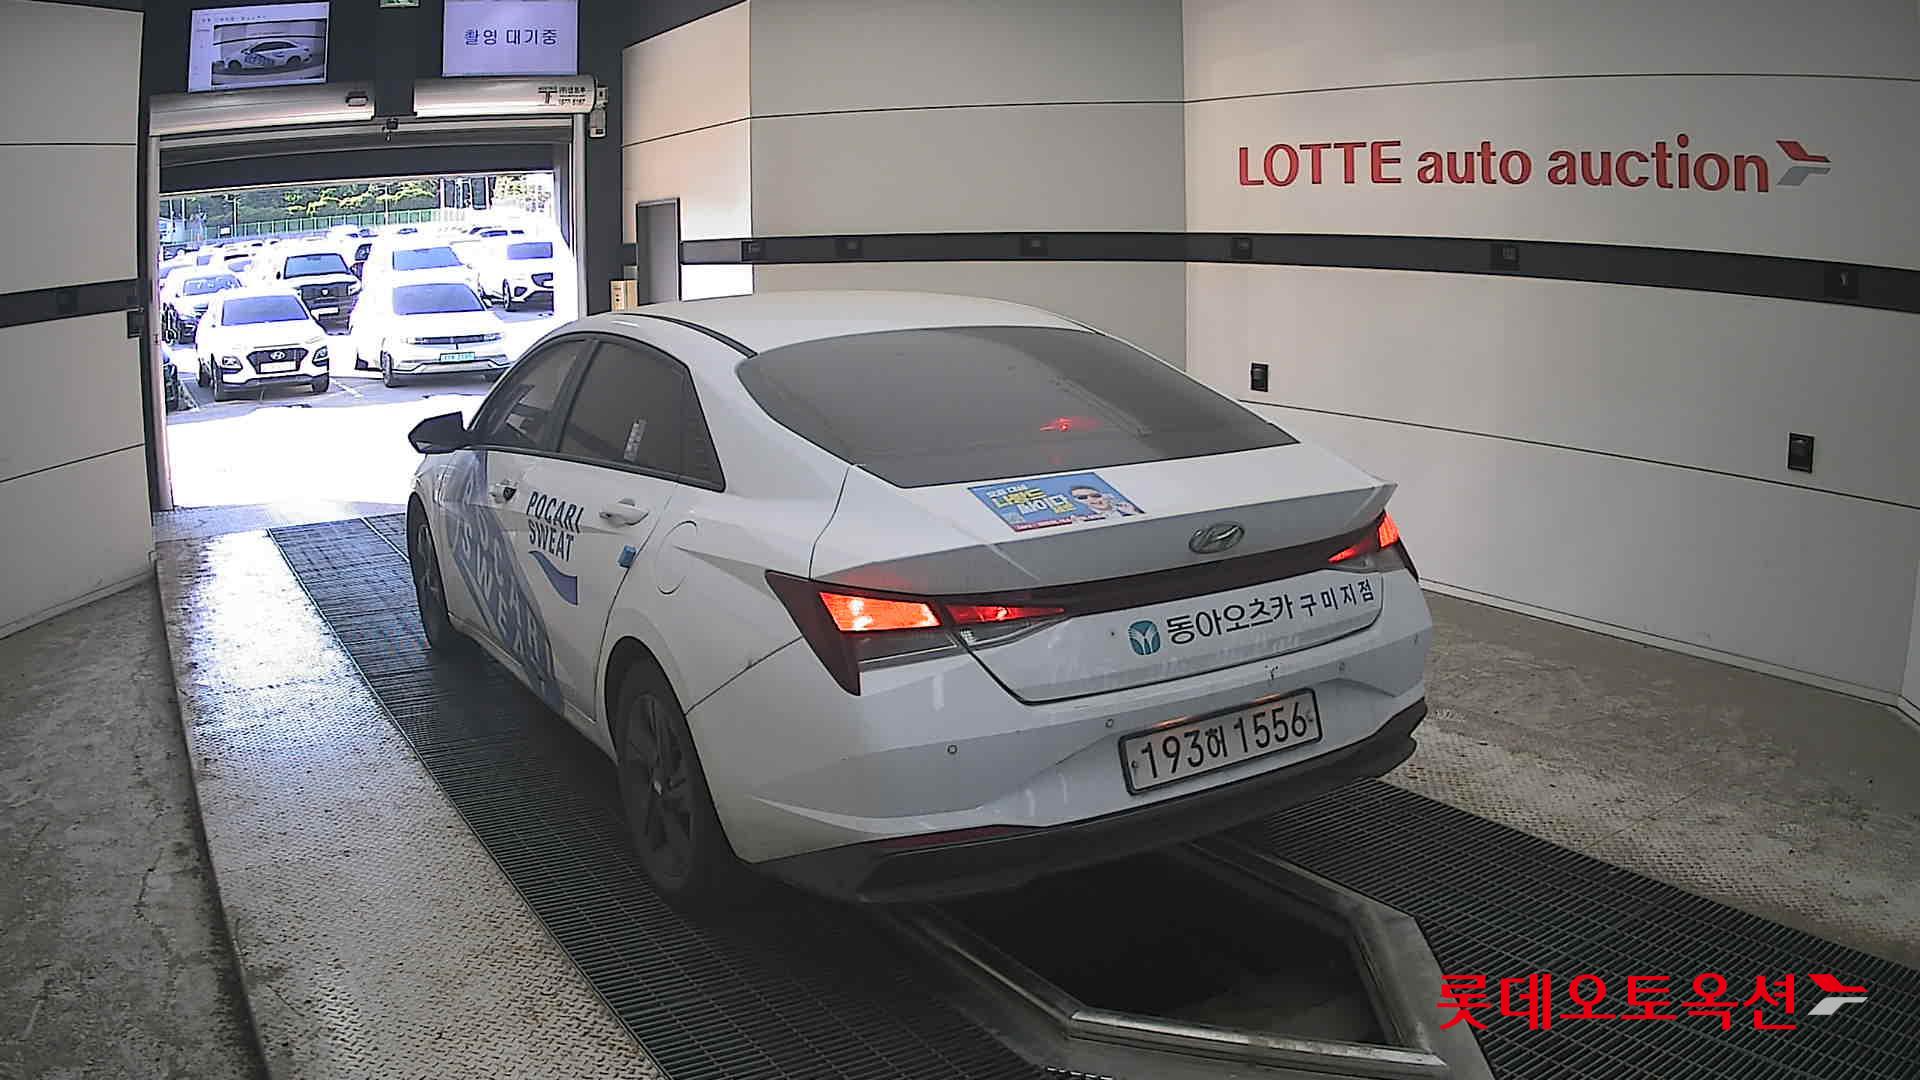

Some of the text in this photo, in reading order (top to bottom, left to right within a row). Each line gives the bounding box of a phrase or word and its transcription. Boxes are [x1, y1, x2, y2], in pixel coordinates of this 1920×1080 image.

[506, 29, 558, 46] 대기중
[1238, 133, 1770, 193] LOTTE auto auction
[526, 491, 584, 534] POCARI
[528, 519, 574, 562] SWEAT
[1166, 579, 1375, 645] 동아오츠카 구미지점
